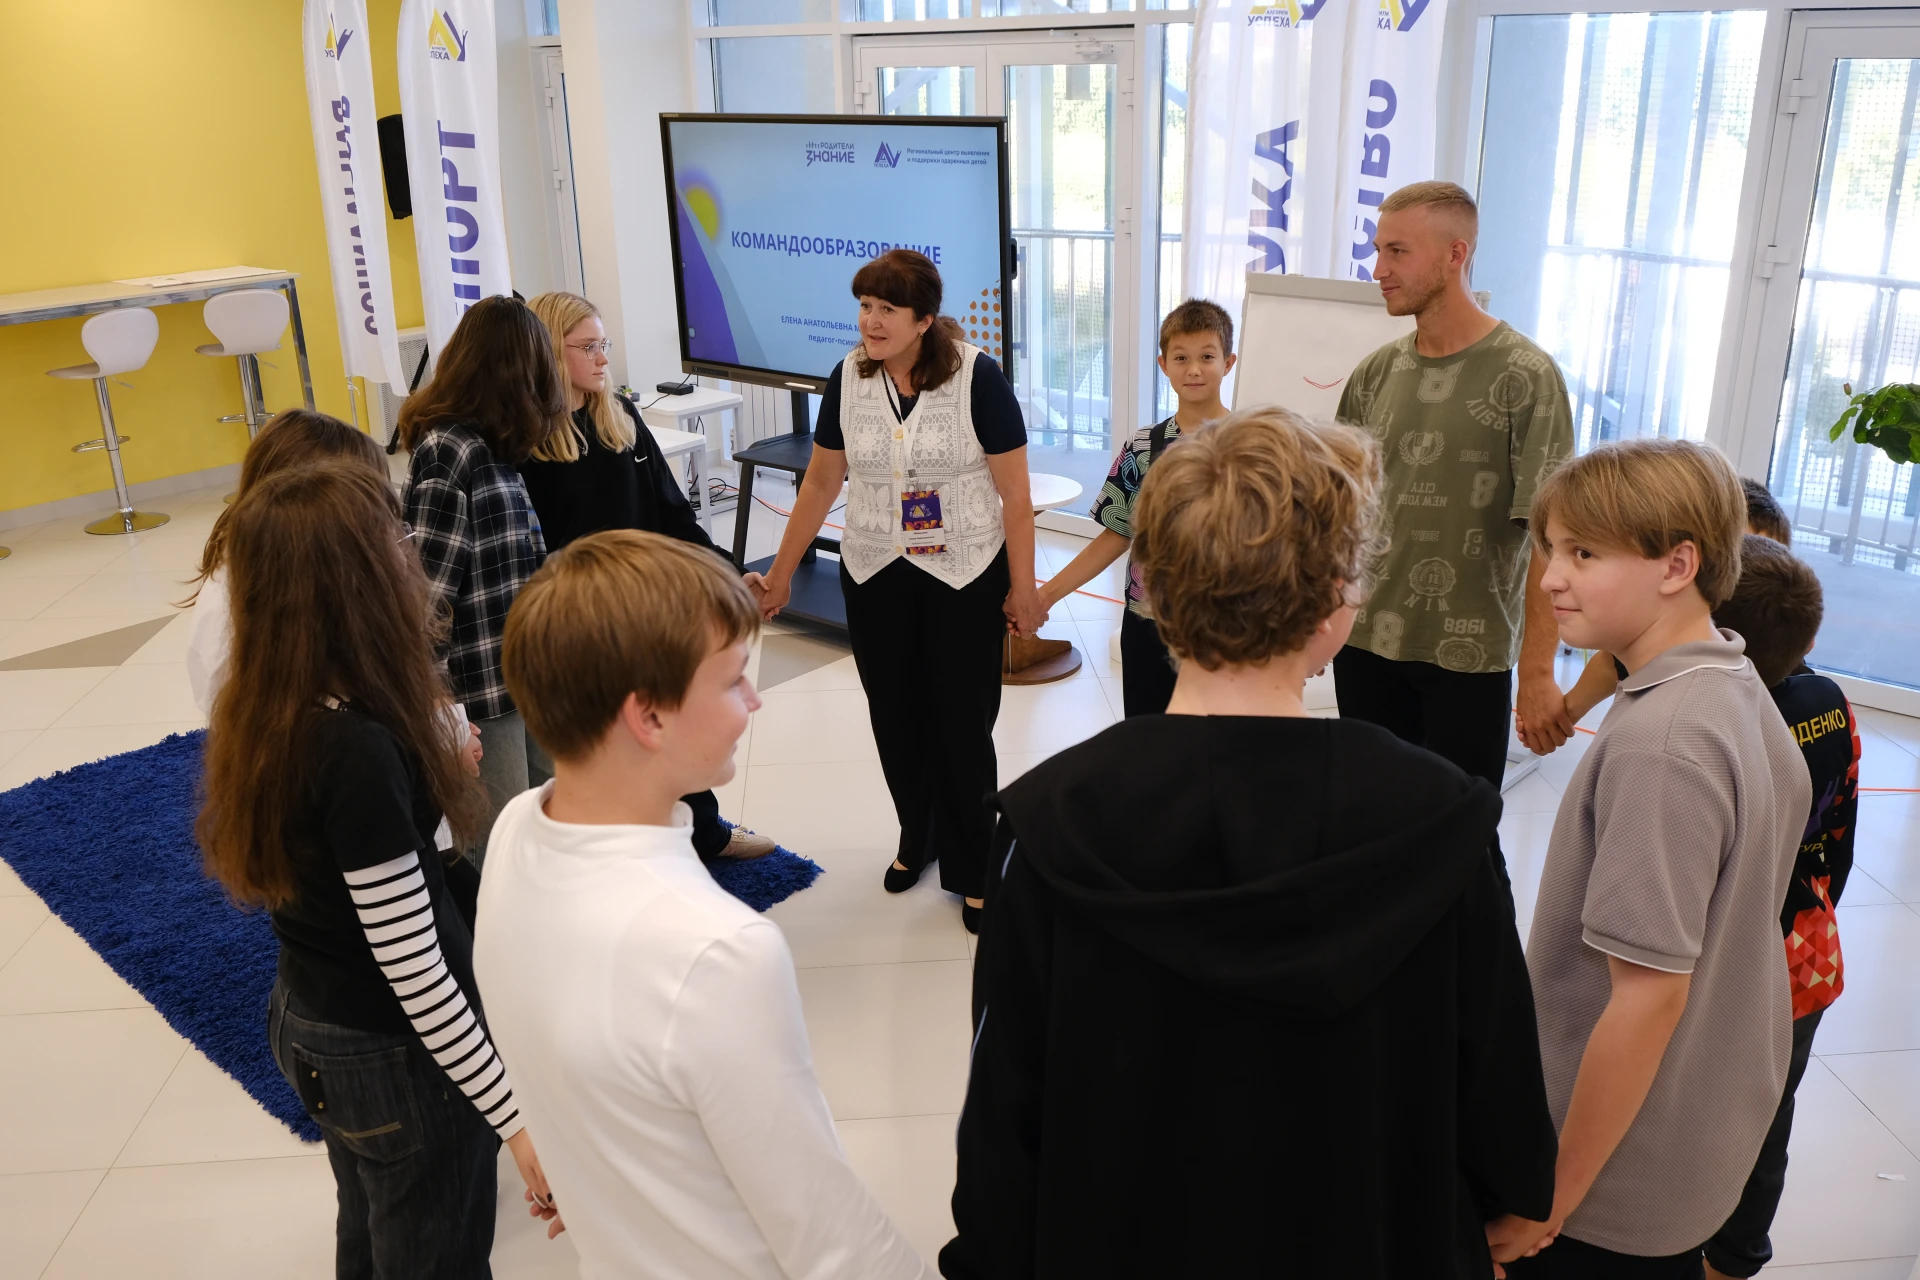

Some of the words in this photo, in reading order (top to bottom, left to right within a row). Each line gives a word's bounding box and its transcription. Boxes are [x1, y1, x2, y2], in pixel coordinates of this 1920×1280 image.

[1247, 15, 1290, 28] УСПЕХА
[430, 50, 450, 60] ПЕХА
[820, 142, 854, 150] РОДИТЕЛИ
[1246, 119, 1300, 275] УКА
[437, 119, 481, 317] ПОРТ
[781, 315, 802, 325] ЕЛЕНА
[803, 318, 853, 332] АНАТОЛЬЕВНА
[808, 334, 857, 346] педагог-психо
[1459, 449, 1489, 462] VIBE
[1411, 482, 1436, 494] CITY
[1470, 470, 1500, 509] 8
[1397, 494, 1420, 506] YORK
[1422, 496, 1448, 507] NEW
[1443, 617, 1486, 635] 1988
[1371, 610, 1405, 660] 8
